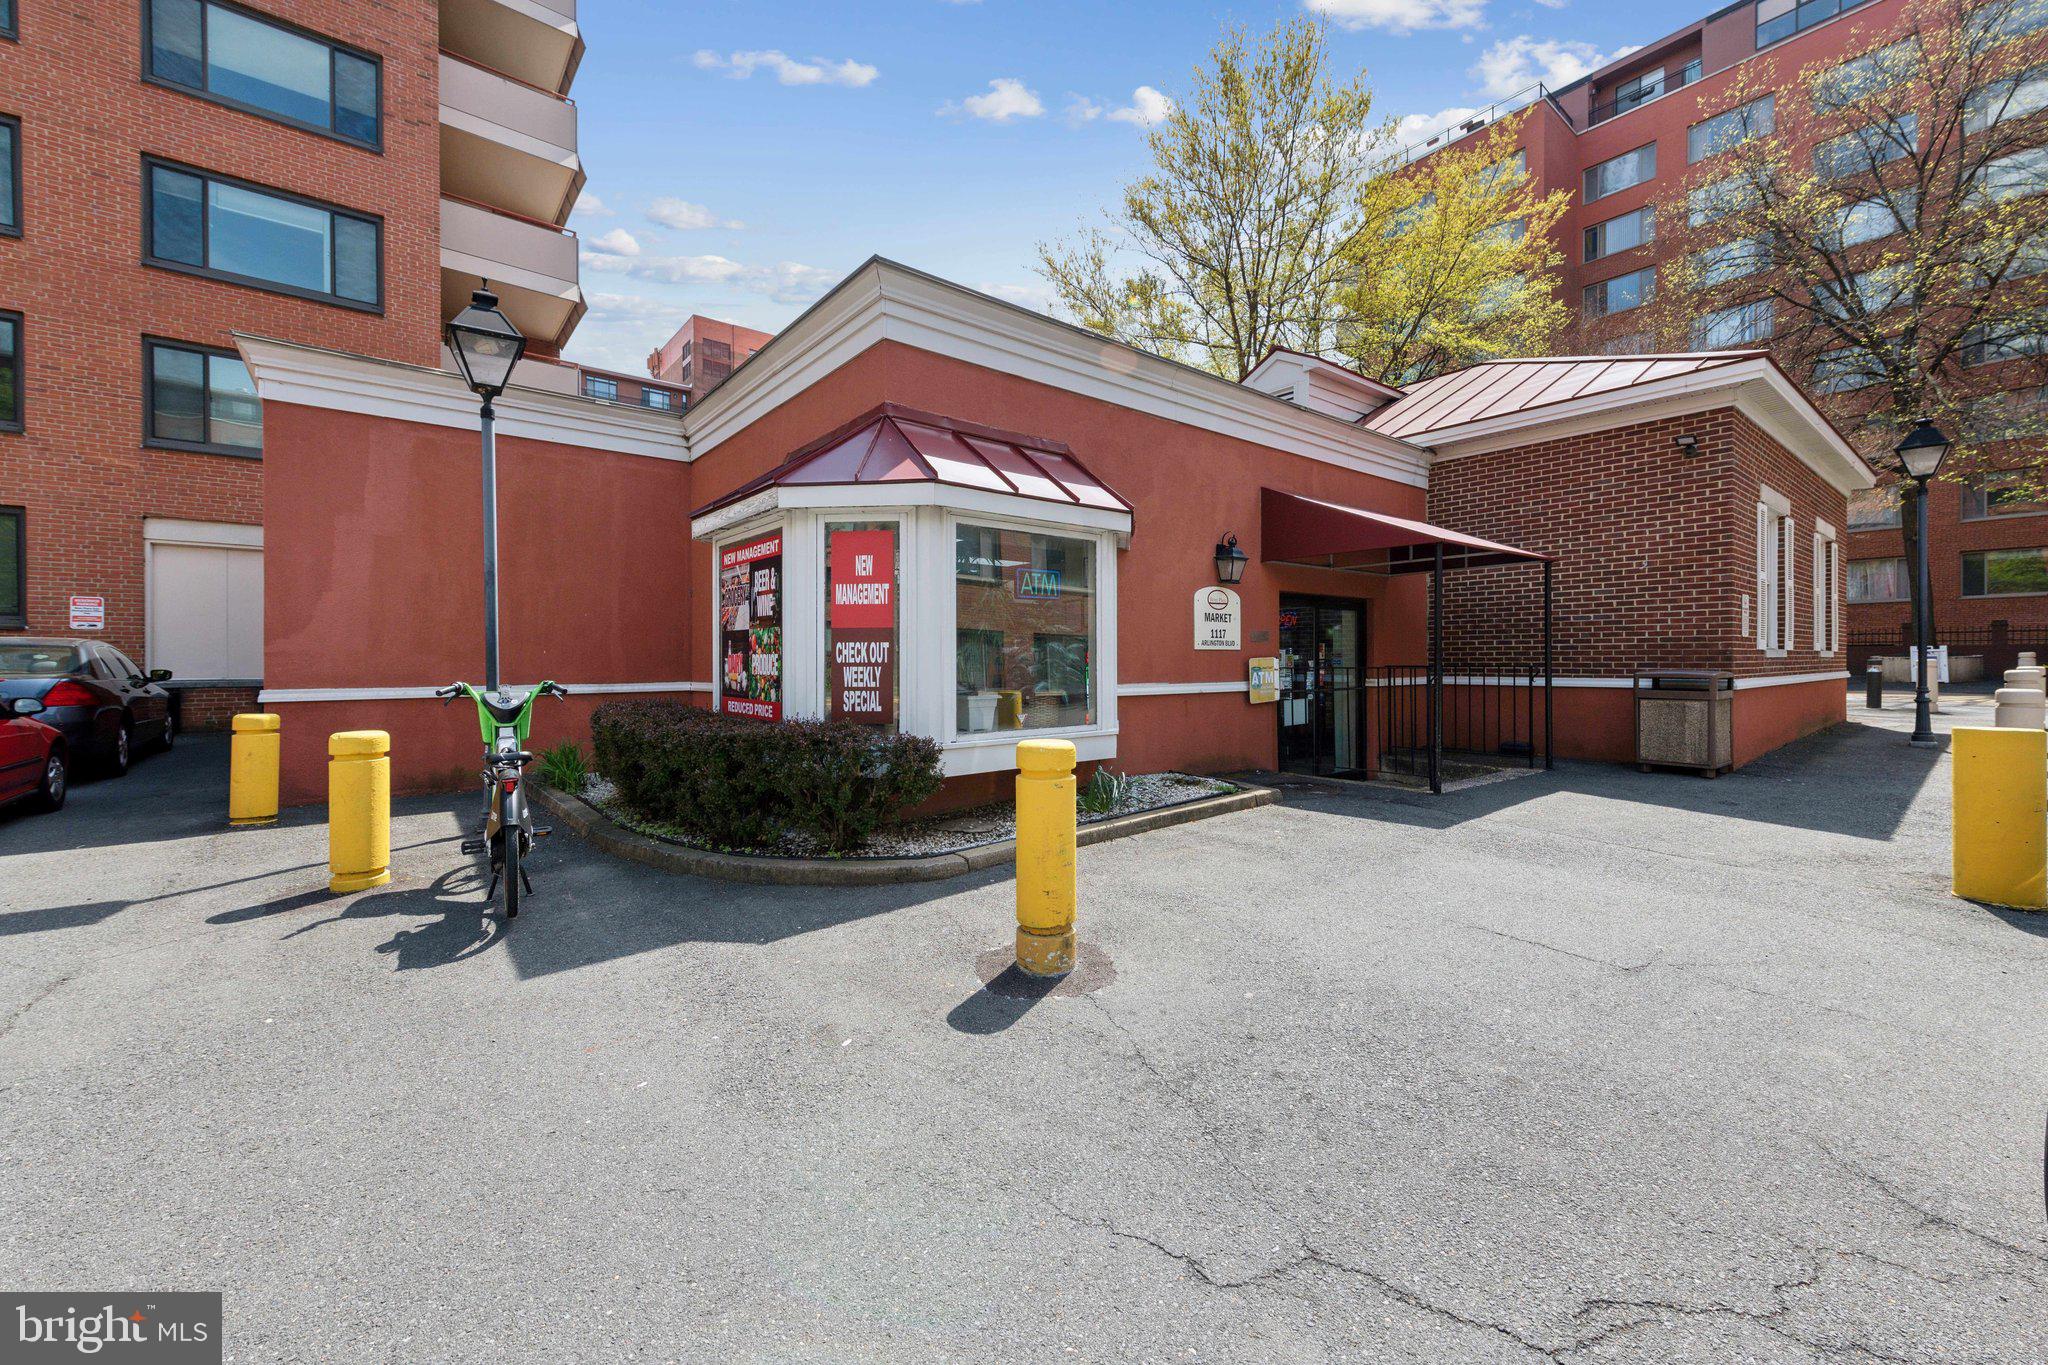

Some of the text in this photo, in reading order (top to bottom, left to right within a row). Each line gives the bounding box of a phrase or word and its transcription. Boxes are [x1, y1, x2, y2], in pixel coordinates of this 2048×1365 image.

[723, 539, 779, 565] NEW MANAGEMENT
[855, 554, 873, 576] NEW
[754, 567, 776, 591] BEER &
[1020, 571, 1057, 596] ATM
[756, 593, 776, 617] WINE
[835, 583, 890, 605] MANAGEMENT
[1204, 612, 1232, 623] MARKET
[1211, 629, 1226, 638] 1117
[835, 641, 889, 664] CHECK OUT
[751, 653, 779, 676] PRODUCE
[843, 666, 881, 688] WEEKLY
[1252, 671, 1274, 685] ATM
[727, 700, 773, 718] REDUCED PRICE
[843, 691, 882, 712] SPECIAL
